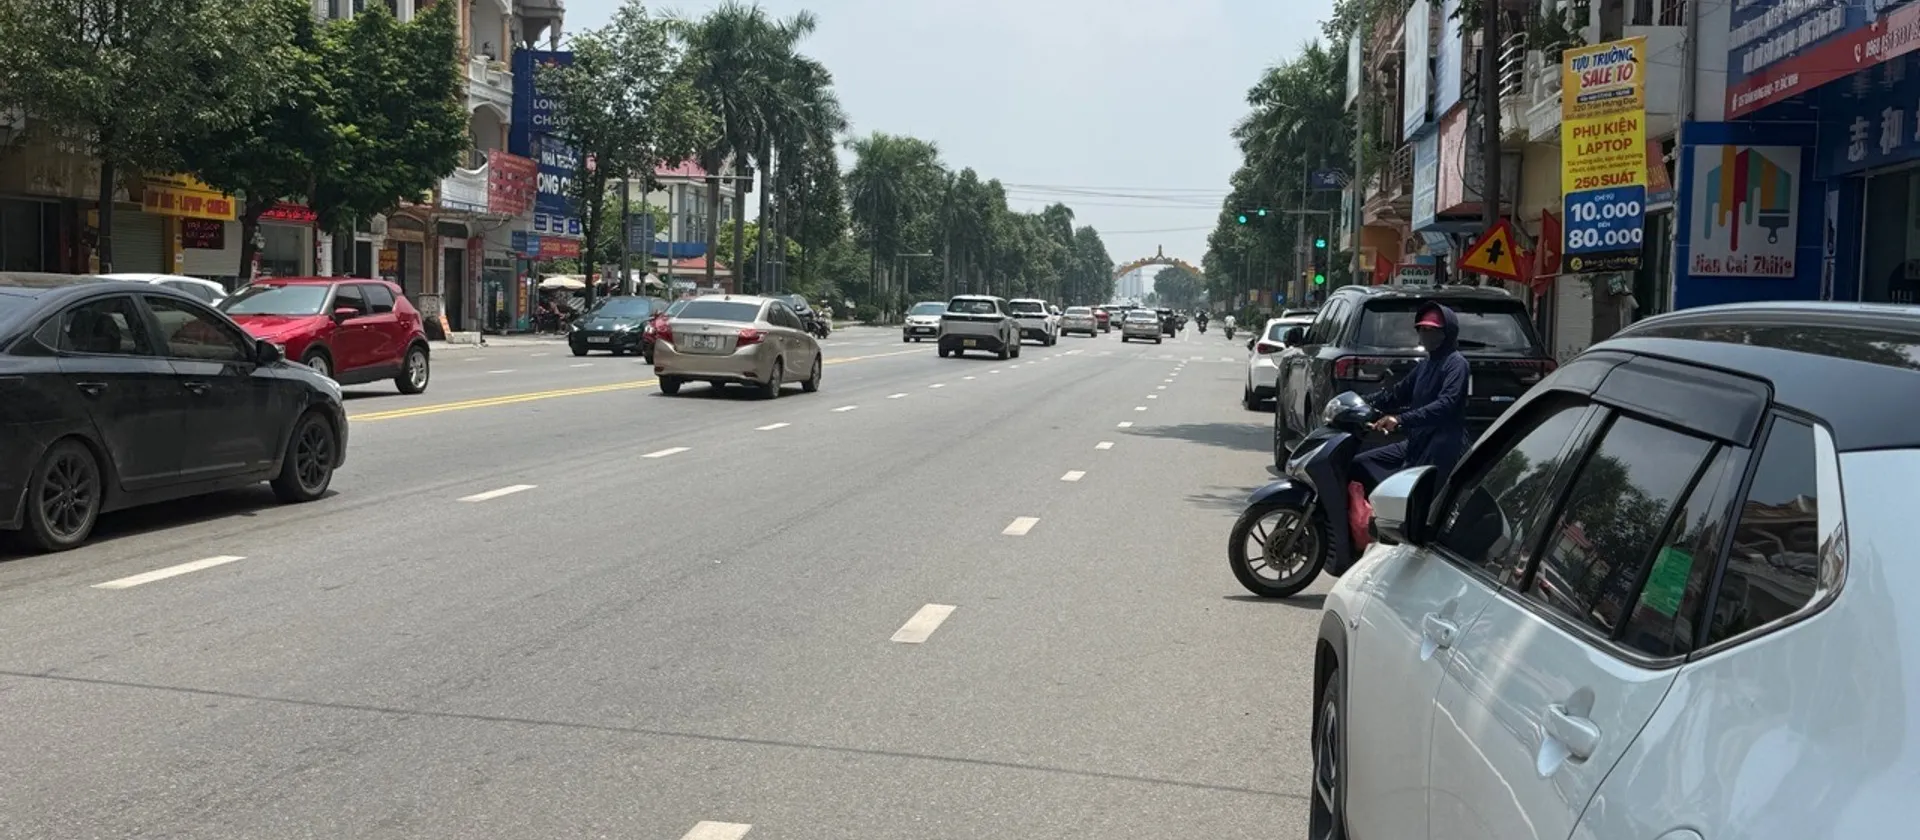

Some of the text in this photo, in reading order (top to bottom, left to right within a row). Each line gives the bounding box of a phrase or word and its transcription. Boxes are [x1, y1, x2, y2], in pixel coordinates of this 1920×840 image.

[1572, 45, 1634, 73] TỰU TRƯỜNG
[1581, 63, 1634, 88] SALE TO
[533, 99, 569, 110] LONG
[1573, 117, 1637, 140] PHỤ KIỆN
[1577, 138, 1633, 156] LAPTOP
[537, 171, 560, 195] ONG
[1574, 176, 1600, 189] 250
[1601, 168, 1636, 186] SUẤT
[1571, 201, 1641, 222] 10.000
[1568, 228, 1643, 249] 80.000
[1692, 253, 1721, 275] Jian
[1725, 255, 1749, 274] Cai
